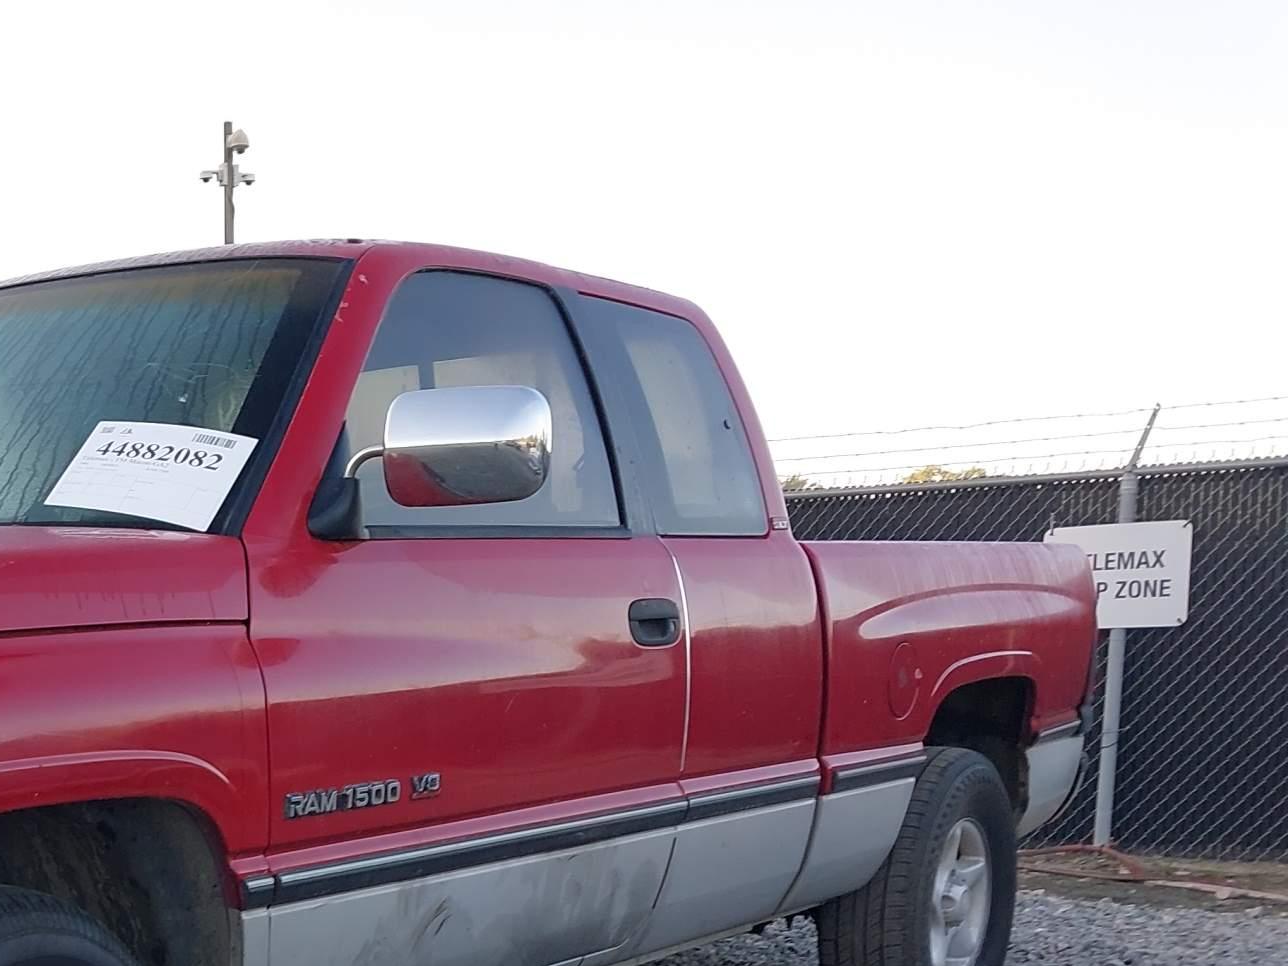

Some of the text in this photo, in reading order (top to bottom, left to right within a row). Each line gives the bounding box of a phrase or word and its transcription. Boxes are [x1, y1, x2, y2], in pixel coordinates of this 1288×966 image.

[96, 440, 223, 471] 44882082
[1086, 550, 1167, 571] LEMAX
[1114, 579, 1172, 599] ZONE
[285, 789, 338, 818] RAM
[343, 779, 401, 809] 1500
